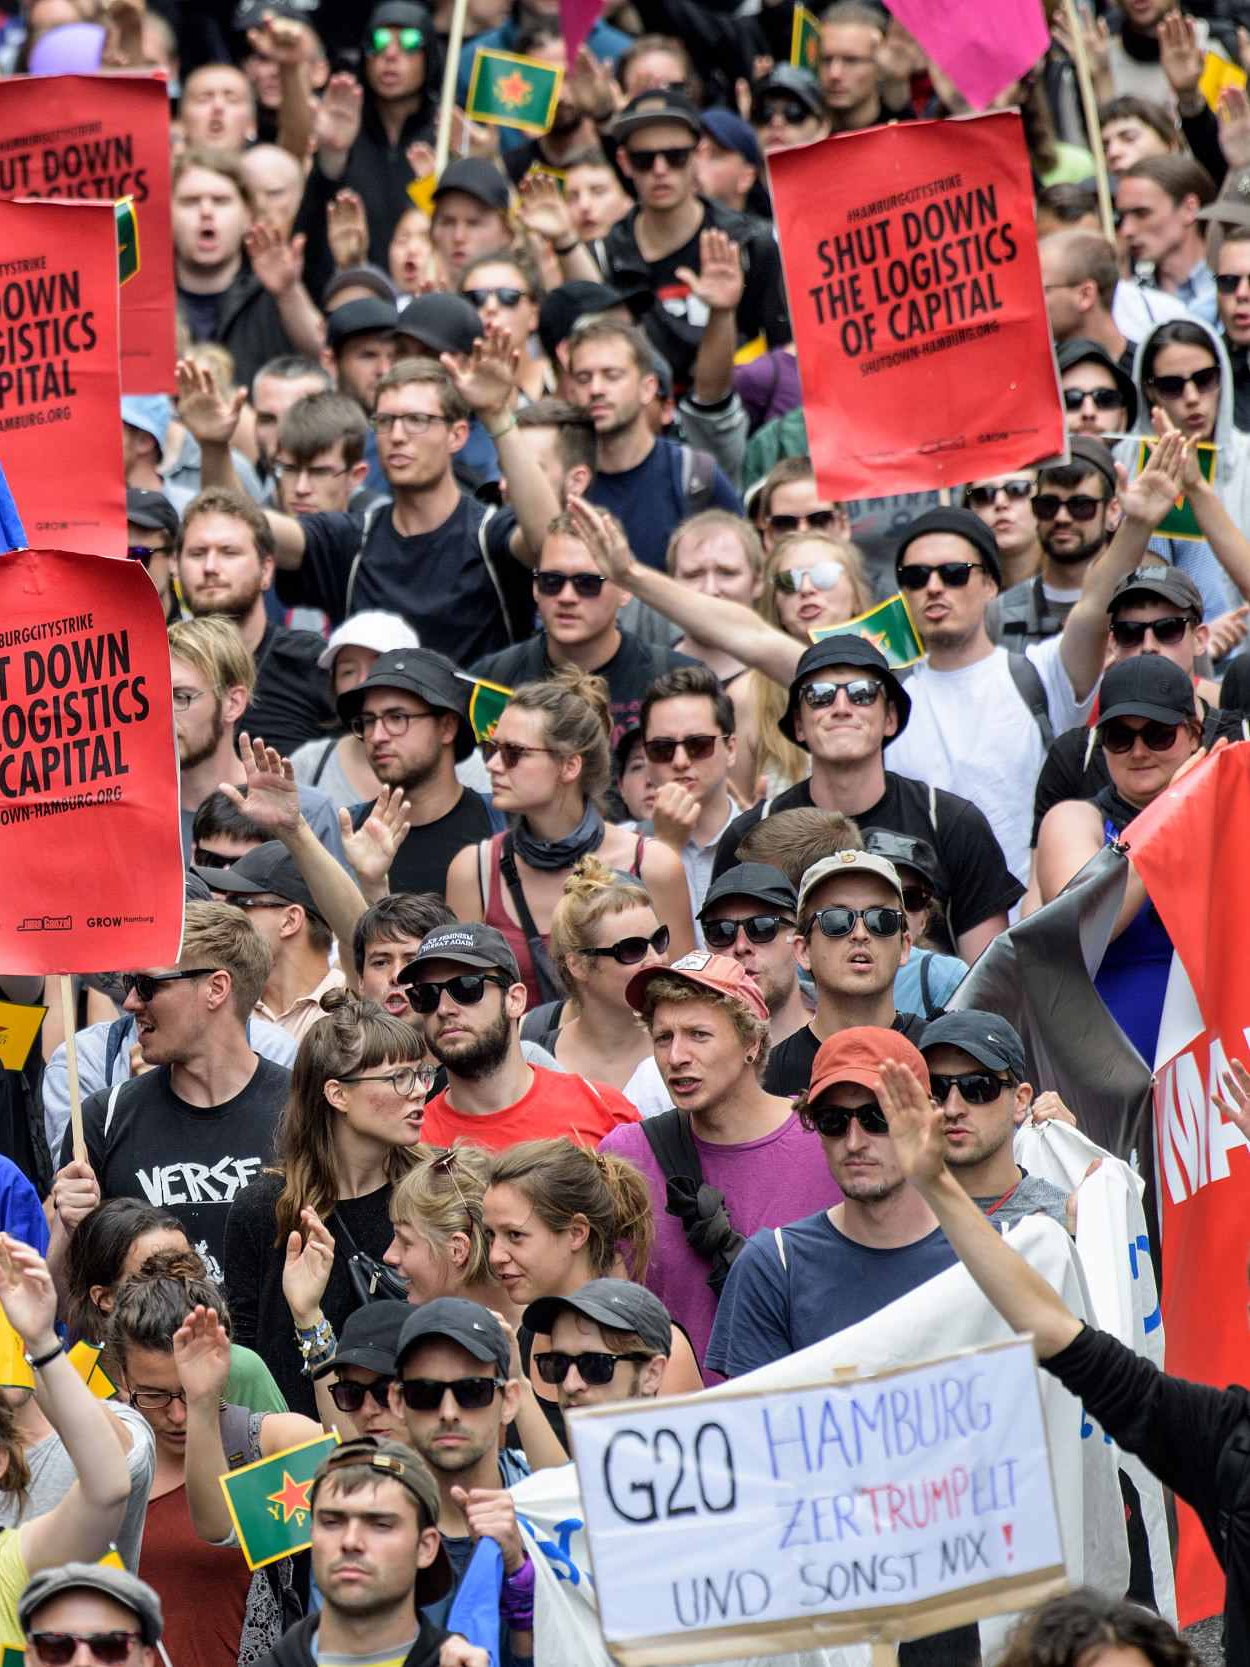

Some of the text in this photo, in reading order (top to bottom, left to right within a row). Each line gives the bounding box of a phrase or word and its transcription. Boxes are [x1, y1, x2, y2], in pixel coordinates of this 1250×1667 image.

[42, 134, 134, 183] DOWN
[817, 184, 997, 280] SHUT DOWN
[809, 223, 1017, 325] THE LOGISTICS
[841, 273, 1003, 358] OF CAPITAL
[25, 630, 130, 696] DOWN
[87, 916, 122, 928] GROW
[123, 915, 154, 924] Hamburg
[450, 938, 473, 947] AGAIN
[602, 1374, 992, 1525] G20 HAMBURG
[671, 1568, 772, 1627] UND
[799, 1551, 922, 1608] SONST
